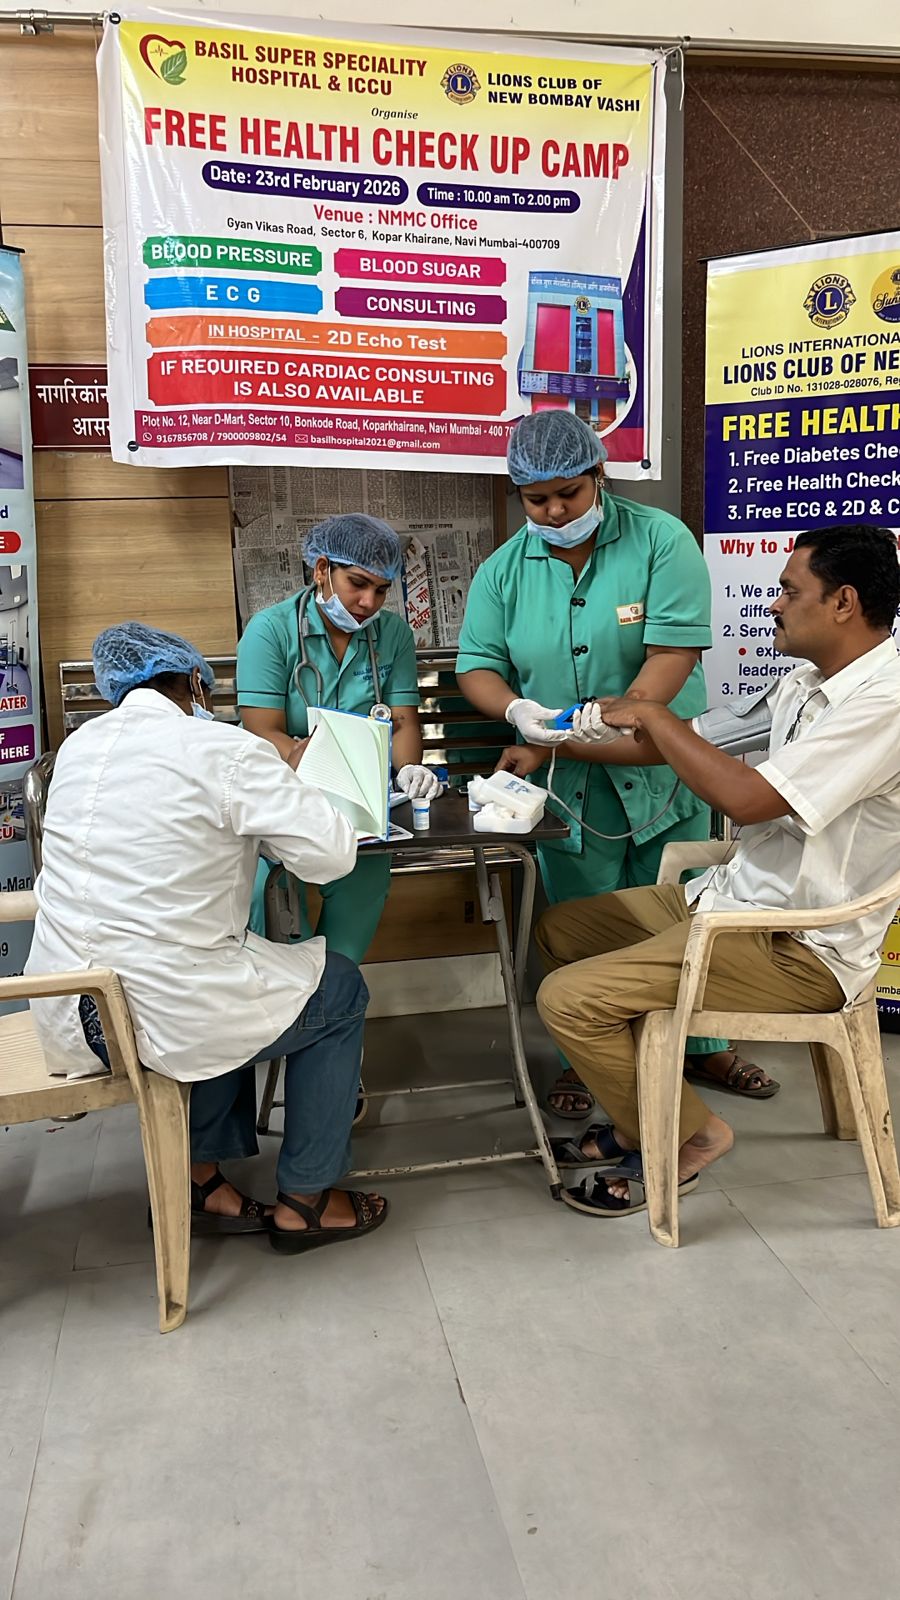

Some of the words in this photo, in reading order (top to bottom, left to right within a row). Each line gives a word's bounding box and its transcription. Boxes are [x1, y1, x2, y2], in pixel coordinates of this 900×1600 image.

[195, 40, 249, 61] BASIL
[255, 45, 316, 67] SUPER
[323, 51, 427, 77] SPECIALITY
[231, 66, 321, 90] HOSPITAL
[327, 75, 341, 92] &
[348, 77, 392, 96] ICCU
[456, 77, 467, 91] L
[488, 73, 532, 88] LIONS
[538, 76, 577, 90] CLUB
[582, 78, 602, 90] OF
[489, 91, 523, 105] NEW
[528, 93, 593, 108] BOMBAY
[597, 97, 640, 112] VASHI
[371, 107, 418, 121] Organise
[144, 107, 227, 152] FREE
[240, 117, 359, 163] HEALTH
[372, 128, 479, 171] CHECK
[490, 135, 530, 174] UP
[541, 139, 630, 180] CAMP
[210, 165, 251, 185] Date:
[255, 169, 290, 189] 23rd
[293, 173, 360, 197] February
[364, 179, 401, 197] 2026
[427, 187, 454, 201] Time
[457, 191, 461, 201] :
[463, 189, 492, 203] 10.00
[493, 193, 511, 204] am
[512, 192, 526, 205] To
[527, 193, 550, 206] 2.00
[553, 196, 570, 209] pm
[313, 204, 363, 223] Venue
[368, 212, 373, 224] :
[378, 209, 426, 228] NMMC
[430, 212, 478, 230] Office
[227, 217, 253, 232] Gyan
[255, 221, 284, 234] Vikas
[287, 223, 316, 237] Road,
[321, 227, 355, 239] Sector
[358, 229, 367, 241] 6,
[372, 230, 403, 245] Kopar
[404, 233, 452, 247] Khairane,
[454, 235, 477, 247] Navi
[479, 237, 560, 250] Mumbai-400709
[151, 243, 212, 260] BLOOD
[216, 245, 313, 267] PRESSURE
[359, 257, 418, 275] BLOOD
[422, 261, 481, 279] SUGAR
[815, 276, 846, 290] LIONS
[206, 285, 218, 301] E
[226, 286, 239, 301] C
[248, 288, 261, 303] G
[823, 291, 838, 310] L
[366, 296, 476, 316] CONSULTING
[208, 324, 225, 337] IN
[228, 325, 306, 341] HOSPITAL
[327, 330, 352, 345] 2D
[356, 332, 403, 349] Echo
[407, 335, 447, 351] Test
[741, 343, 784, 359] LIONS
[788, 332, 900, 354] INTERNATIONA
[160, 360, 177, 376] IF
[181, 359, 279, 377] REQUIRED
[284, 362, 371, 381] CARDIAC
[375, 367, 494, 386] CONSULTING
[723, 361, 777, 385] LIONS
[783, 356, 833, 379] CLUB
[841, 352, 867, 373] OF
[874, 350, 900, 371] NE
[233, 381, 252, 396] IS
[257, 382, 310, 399] ALSO
[315, 384, 424, 404] AVAILABLE
[751, 385, 772, 397] Club
[774, 385, 784, 395] ID
[787, 383, 803, 394] No.
[807, 377, 882, 392] 131028-028076,
[72, 418, 110, 436] आस
[142, 415, 160, 427] Plot
[162, 416, 176, 426] No.
[178, 415, 191, 428] 12,
[192, 414, 211, 426] Near
[214, 414, 246, 426] D-Mart,
[248, 414, 277, 426] Sector
[280, 415, 292, 428] 10,
[294, 416, 333, 429] Bonkode
[335, 419, 360, 431] Road,
[362, 419, 427, 434] Koparkhairane,
[429, 422, 447, 434] Navi
[450, 423, 481, 436] Mumbai
[488, 425, 503, 437] 400
[722, 411, 790, 442] FREE
[801, 403, 900, 437] HEALTH
[156, 432, 208, 443] 9167856708
[217, 433, 287, 442] 7900009802/54
[310, 435, 441, 449] basilhospital2021@gmail.com
[728, 451, 740, 467] 1.
[744, 450, 780, 466] Free
[784, 446, 860, 464] Diabetes
[864, 443, 900, 459] Che
[728, 478, 743, 494] 2.
[747, 477, 783, 493] Free
[787, 473, 842, 491] Health
[847, 470, 900, 488] Check
[727, 504, 742, 520] 3.
[746, 504, 782, 519] Free
[786, 501, 821, 518] ECG
[824, 501, 837, 517] &
[841, 500, 865, 516] 2D
[869, 499, 883, 515] &
[720, 539, 755, 557] Why
[760, 538, 778, 553] to
[725, 586, 736, 598] 1.
[741, 584, 763, 598] We
[723, 624, 735, 638] 2.
[721, 683, 733, 695] 3.
[1, 745, 30, 760] HERE
